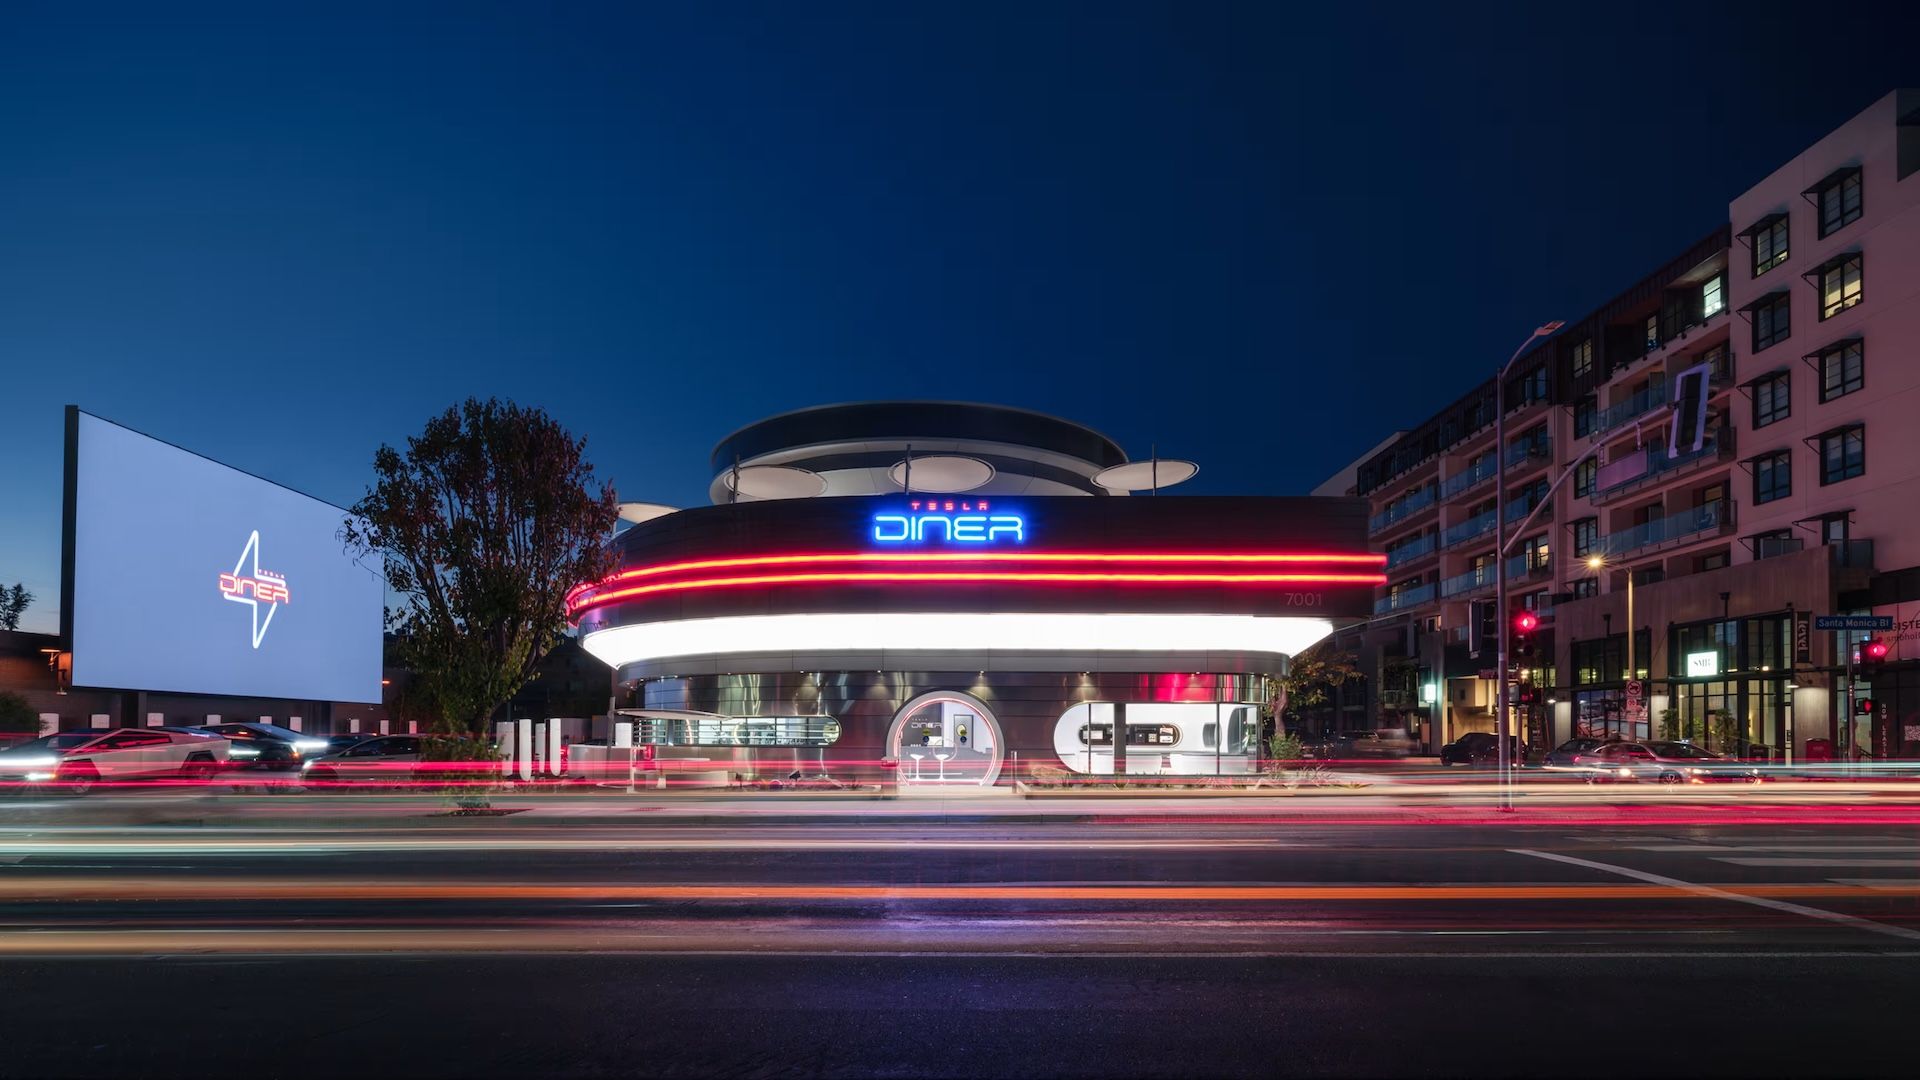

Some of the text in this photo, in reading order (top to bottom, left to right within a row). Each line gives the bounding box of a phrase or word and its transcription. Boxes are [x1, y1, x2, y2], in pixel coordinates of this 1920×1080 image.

[911, 502, 988, 511] TESLA
[874, 515, 1023, 541] DINER
[220, 574, 289, 604] DINER
[1284, 592, 1322, 607] 7001
[1818, 619, 1843, 628] Santa
[1845, 619, 1877, 627] Monica
[1798, 620, 1809, 651] level
